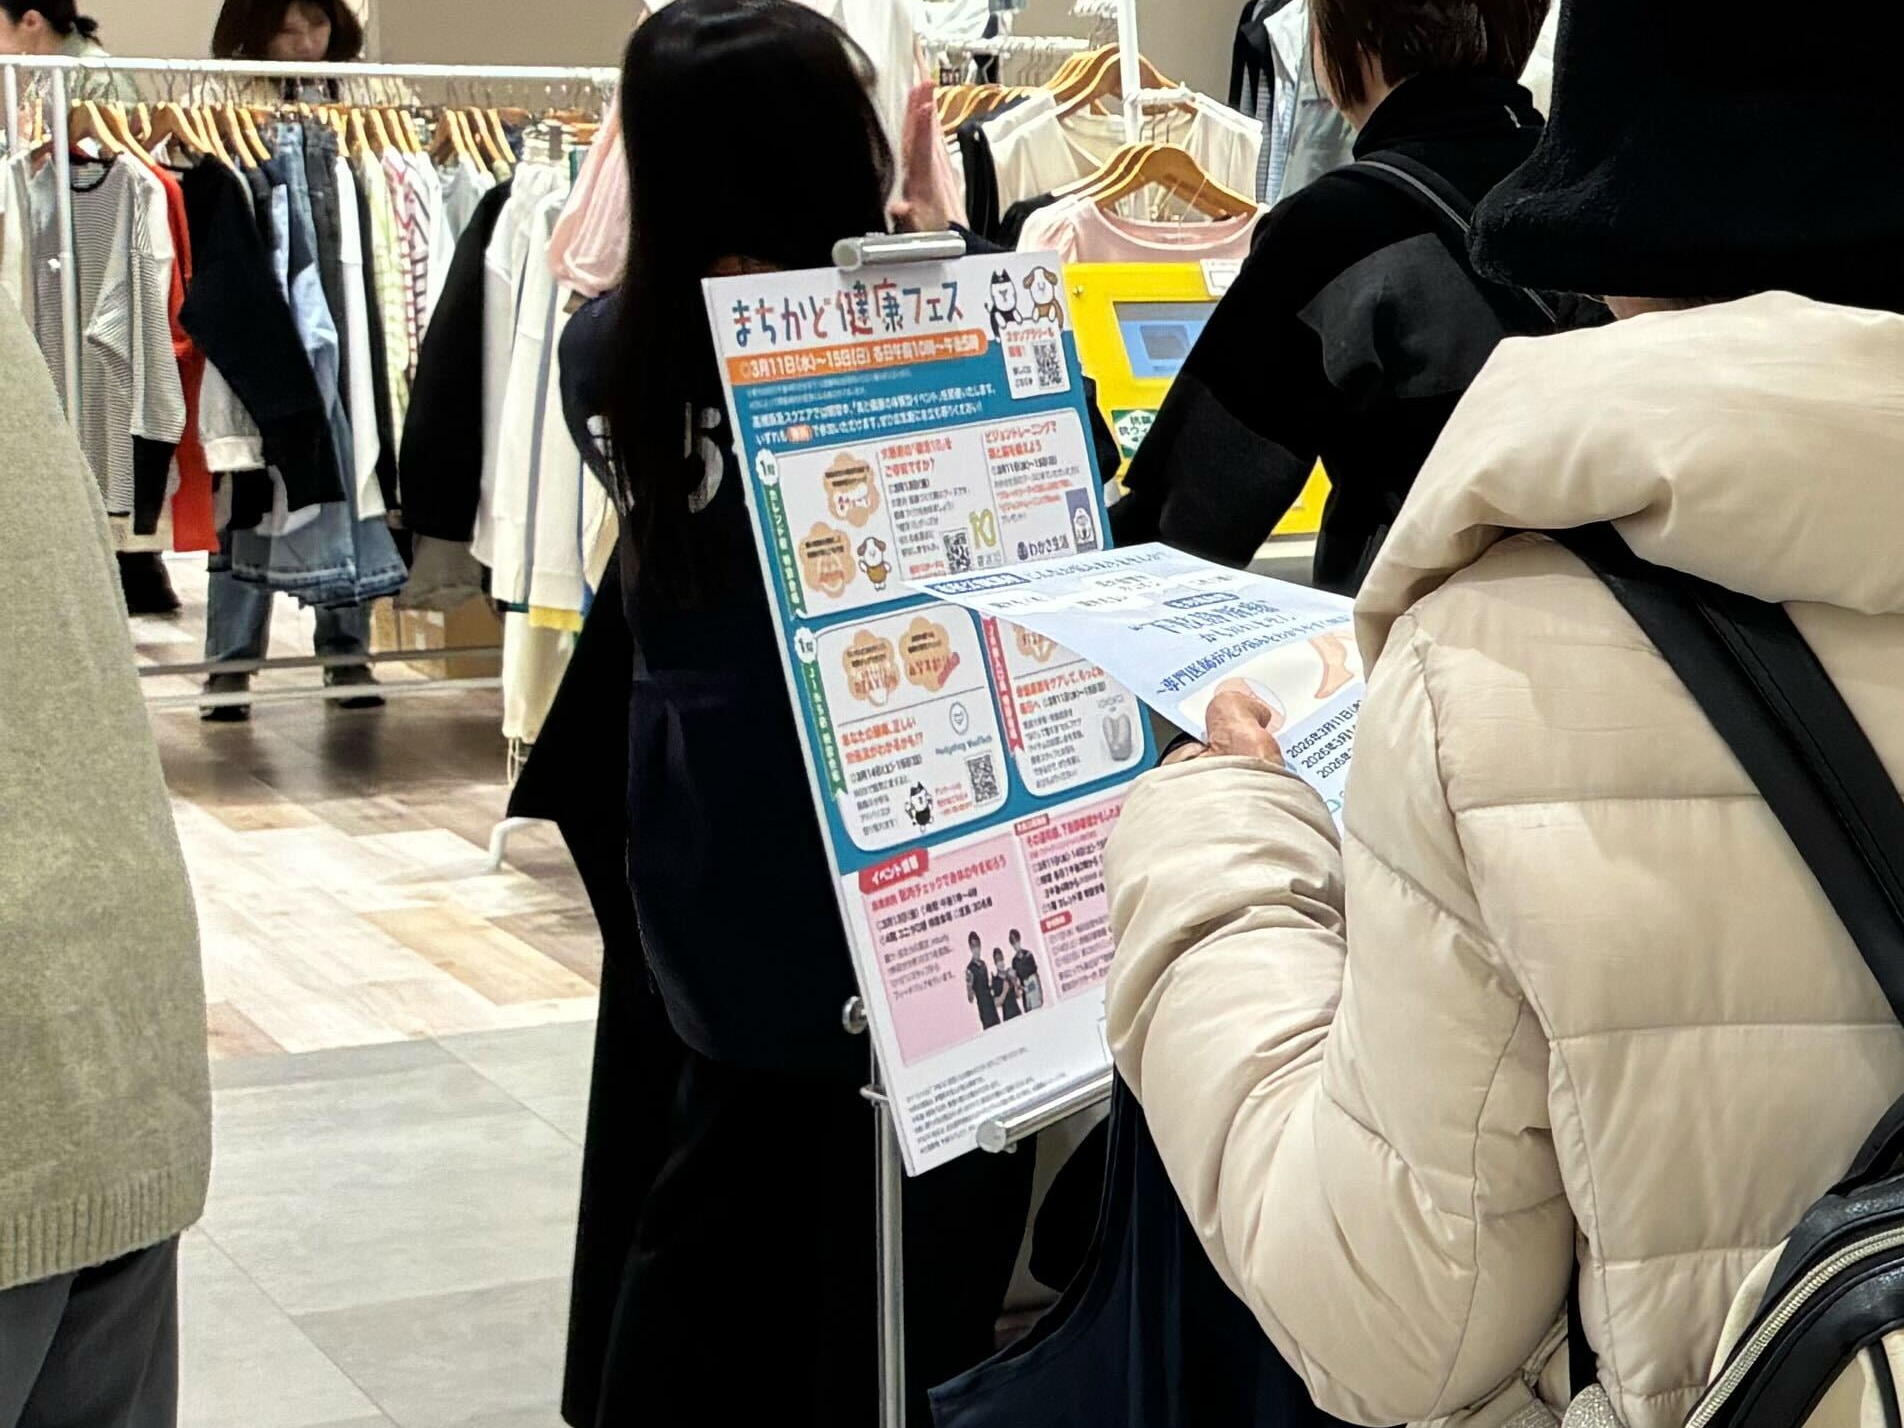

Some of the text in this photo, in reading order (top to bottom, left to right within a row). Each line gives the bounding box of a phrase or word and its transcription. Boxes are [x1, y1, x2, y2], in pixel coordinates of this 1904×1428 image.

[732, 278, 963, 347] まちかど健康フェス
